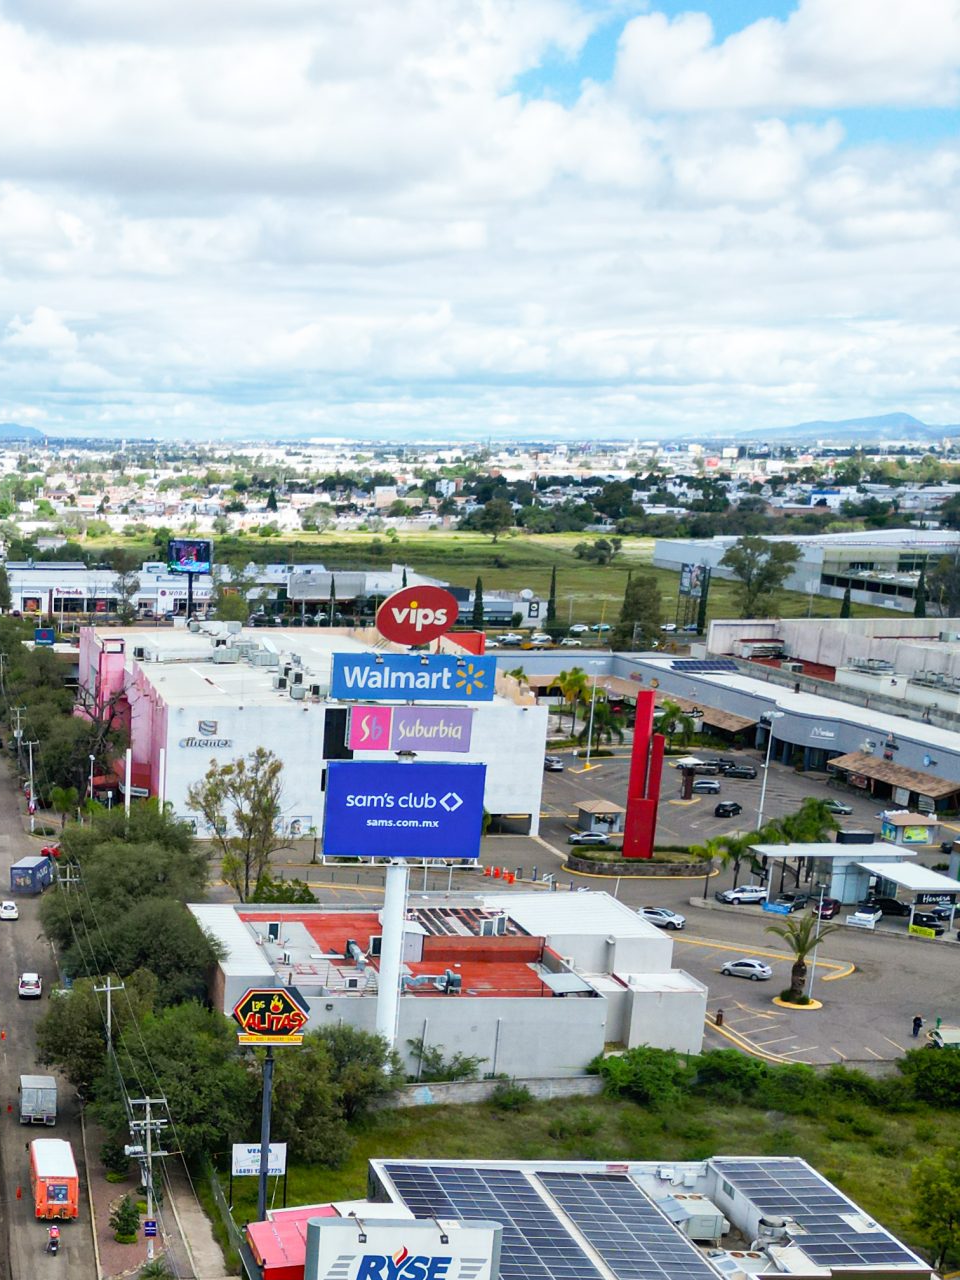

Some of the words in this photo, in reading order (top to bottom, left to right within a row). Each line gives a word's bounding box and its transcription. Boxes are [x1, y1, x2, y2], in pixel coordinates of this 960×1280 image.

[391, 600, 448, 632] vips
[343, 665, 452, 690] Walmart
[398, 719, 462, 741] Suburbia
[346, 792, 395, 809] sam's
[397, 792, 437, 809] club
[366, 818, 439, 828] sams.com.mx
[922, 894, 951, 903] Herrera
[244, 1011, 302, 1031] ALITAS
